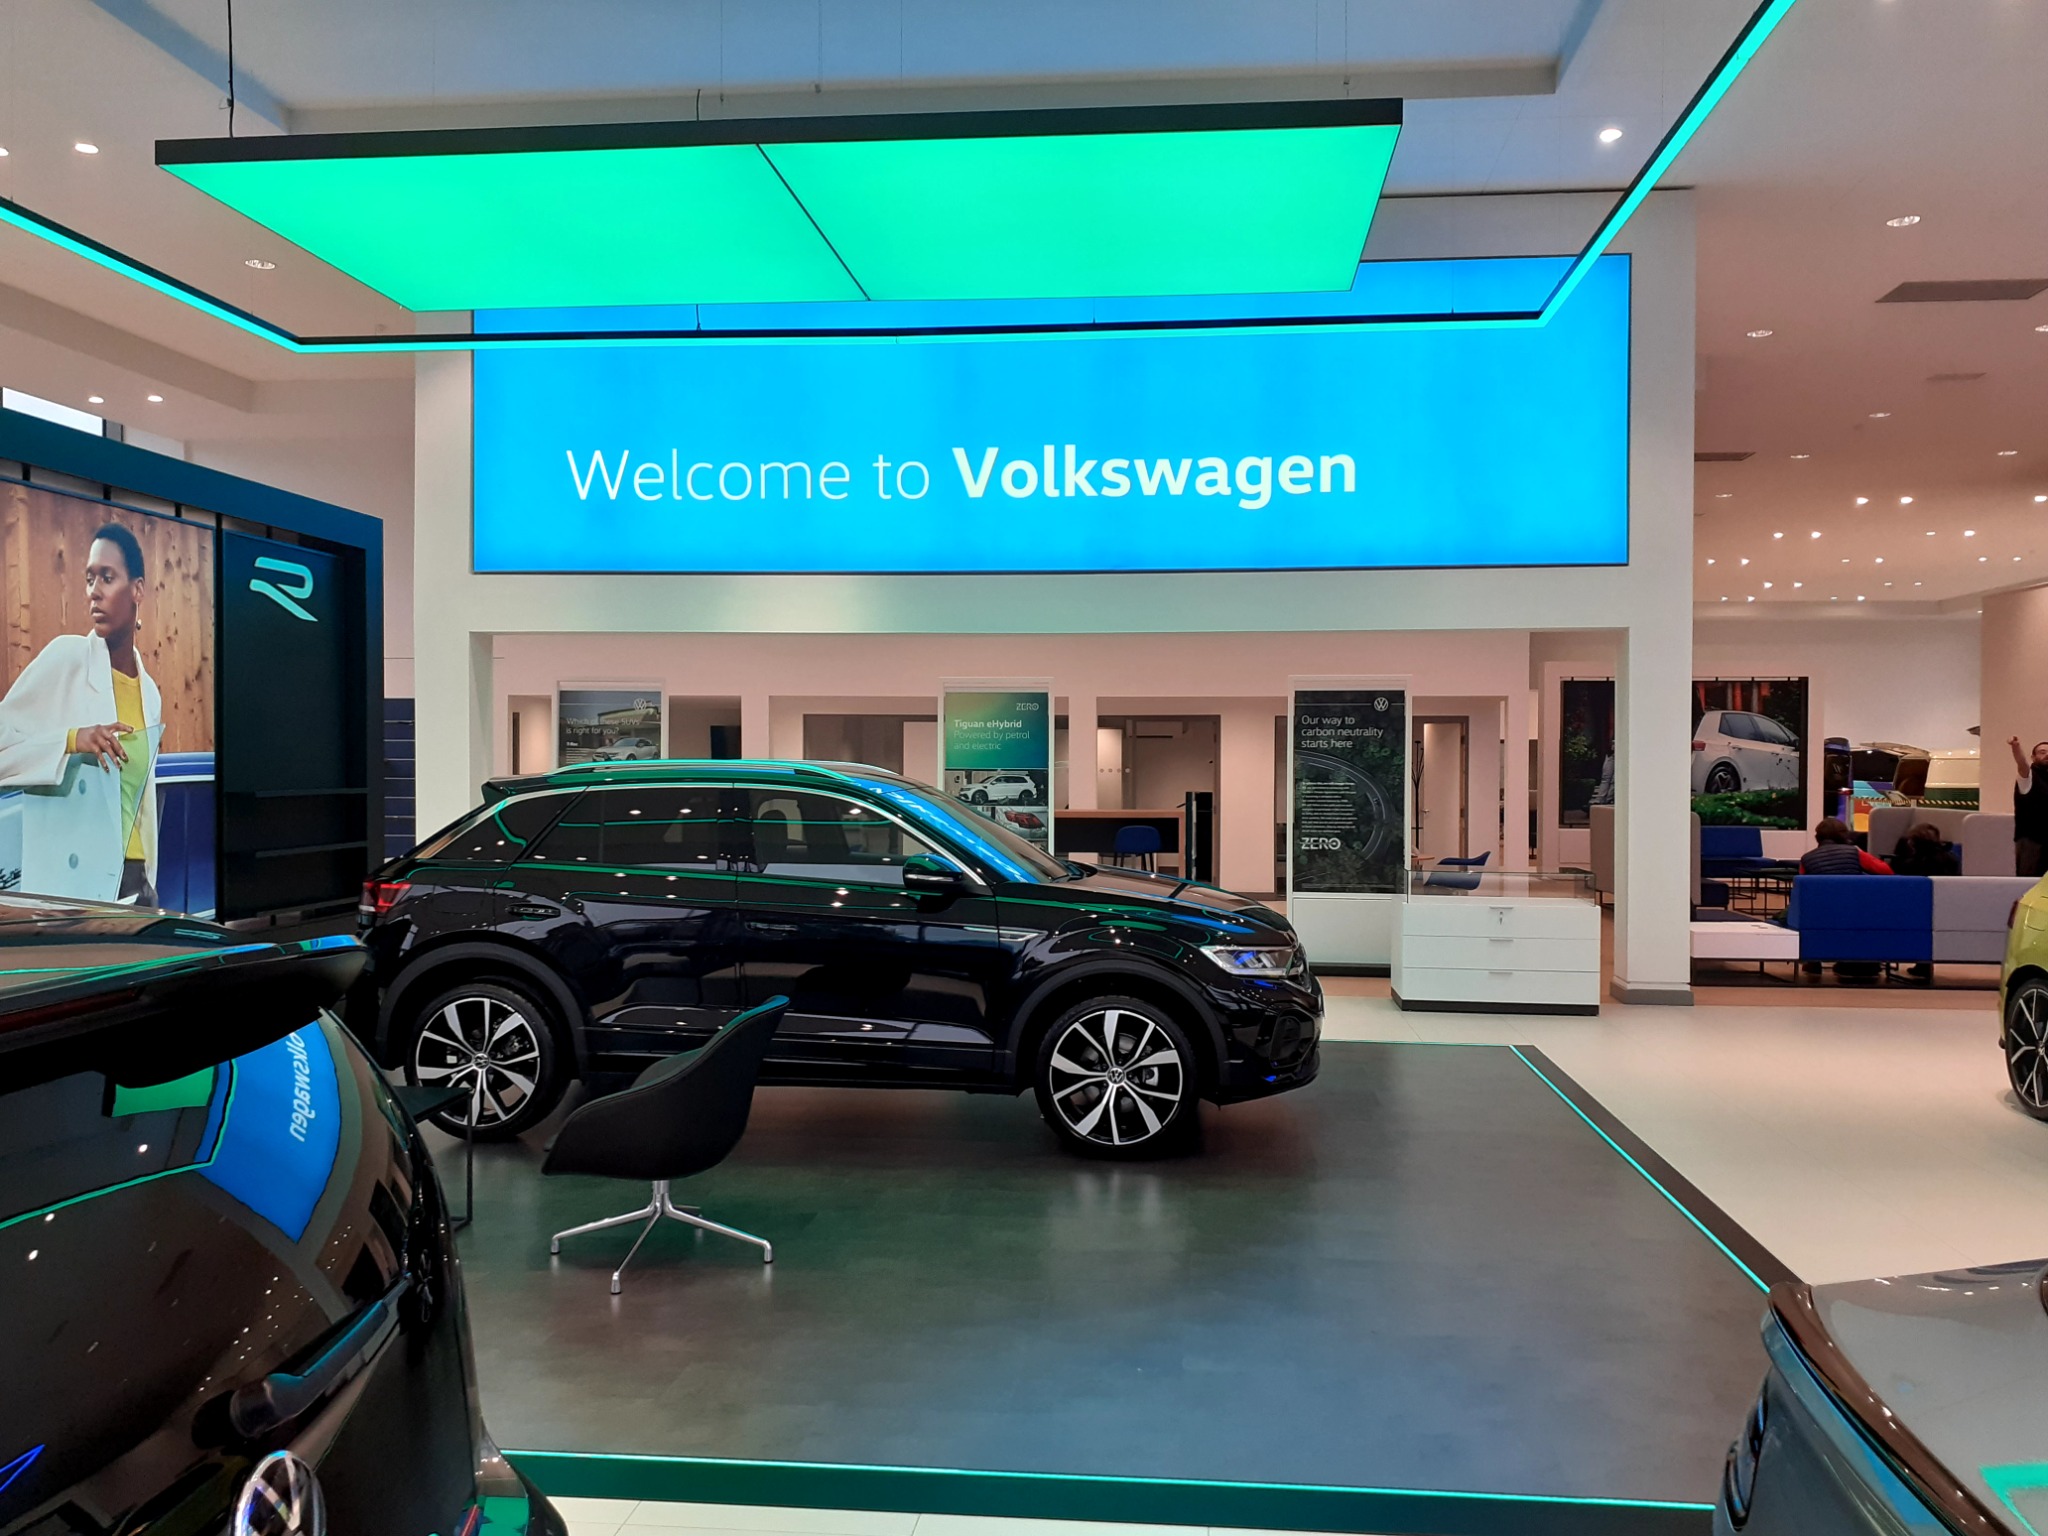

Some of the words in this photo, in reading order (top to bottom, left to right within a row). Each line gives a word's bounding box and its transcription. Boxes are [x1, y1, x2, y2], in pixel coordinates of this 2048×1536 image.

[566, 447, 851, 501] Welcome
[872, 453, 930, 500] to
[951, 444, 1356, 510] Volkswagen
[249, 556, 318, 622] R
[1016, 702, 1040, 711] ZERO
[621, 717, 641, 726] SUVs
[954, 719, 985, 730] Tiguan
[987, 719, 1022, 730] eHybrid
[1301, 715, 1320, 725] Our
[1321, 716, 1343, 727] way
[1344, 716, 1355, 725] to
[573, 726, 590, 736] right
[591, 726, 602, 734] for
[602, 726, 620, 736] you?
[954, 730, 991, 739] Powered
[993, 730, 1004, 740] by
[1005, 730, 1030, 740] petrol
[1301, 727, 1336, 737] carbon
[1337, 727, 1384, 739] neutrality
[954, 742, 970, 750] and
[971, 742, 1002, 750] electric
[1301, 739, 1329, 748] starts
[1330, 739, 1353, 748] here
[1300, 837, 1341, 850] ZERO
